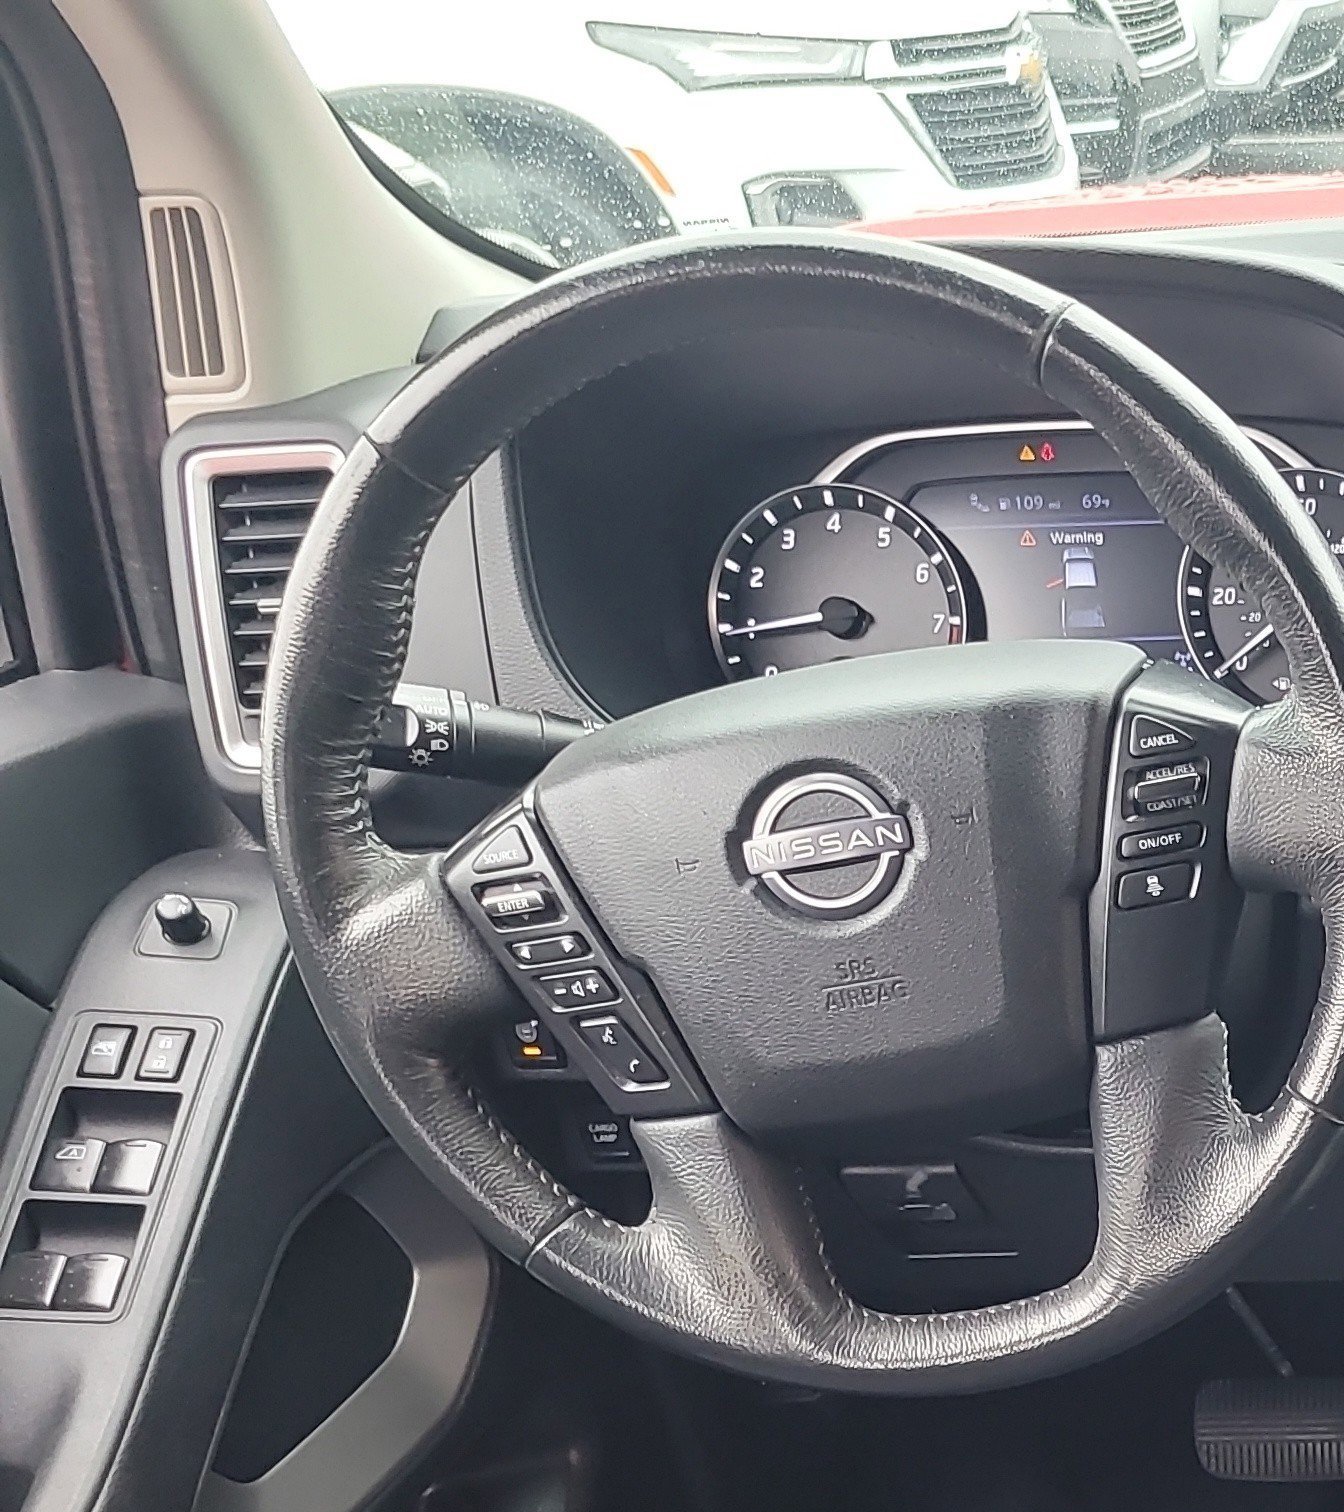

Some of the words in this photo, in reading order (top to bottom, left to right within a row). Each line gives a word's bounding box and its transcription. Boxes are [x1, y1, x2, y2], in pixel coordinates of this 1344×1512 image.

[1015, 494, 1043, 510] 109
[826, 512, 842, 533] 4
[781, 528, 795, 549] 3
[877, 527, 891, 548] 5
[1050, 531, 1104, 545] Warning
[750, 567, 764, 588] 2
[915, 563, 930, 583] 6
[1212, 587, 1236, 605] 20
[932, 614, 945, 634] 7
[1248, 611, 1261, 622] 20
[1140, 733, 1179, 749] CANCEL
[1146, 762, 1196, 780] ACCEL/RES
[751, 823, 904, 869] NISSAN
[1138, 832, 1183, 850] ON/OFF
[483, 850, 519, 865] SOURCE
[497, 899, 530, 912] ENTER
[833, 956, 879, 982] SRS
[825, 981, 911, 1011] AIRBAG
